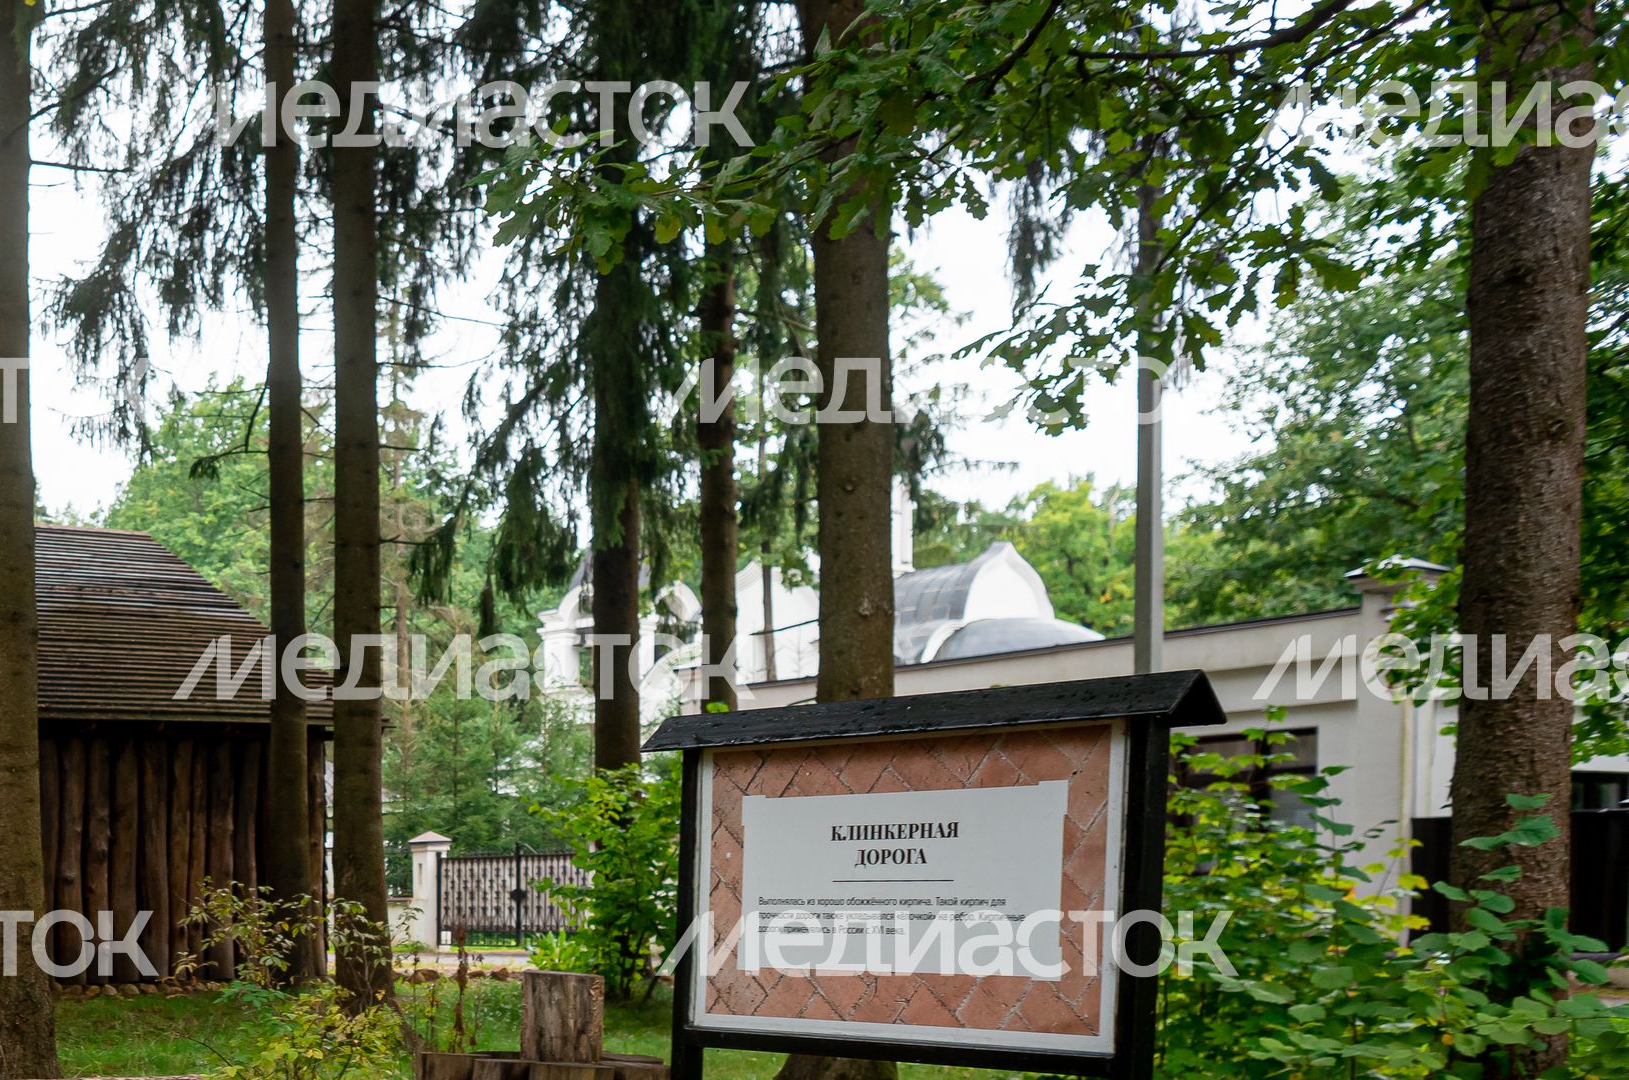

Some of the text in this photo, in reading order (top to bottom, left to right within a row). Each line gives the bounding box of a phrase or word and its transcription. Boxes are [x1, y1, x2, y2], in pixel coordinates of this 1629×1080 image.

[831, 821, 959, 841] КЛИНКЕРНАЯ
[854, 848, 927, 868] ДОРОГА
[807, 897, 816, 906] из
[817, 896, 844, 907] хорошо
[936, 896, 958, 907] Такой
[960, 896, 988, 907] кирпич
[991, 896, 1005, 907] для
